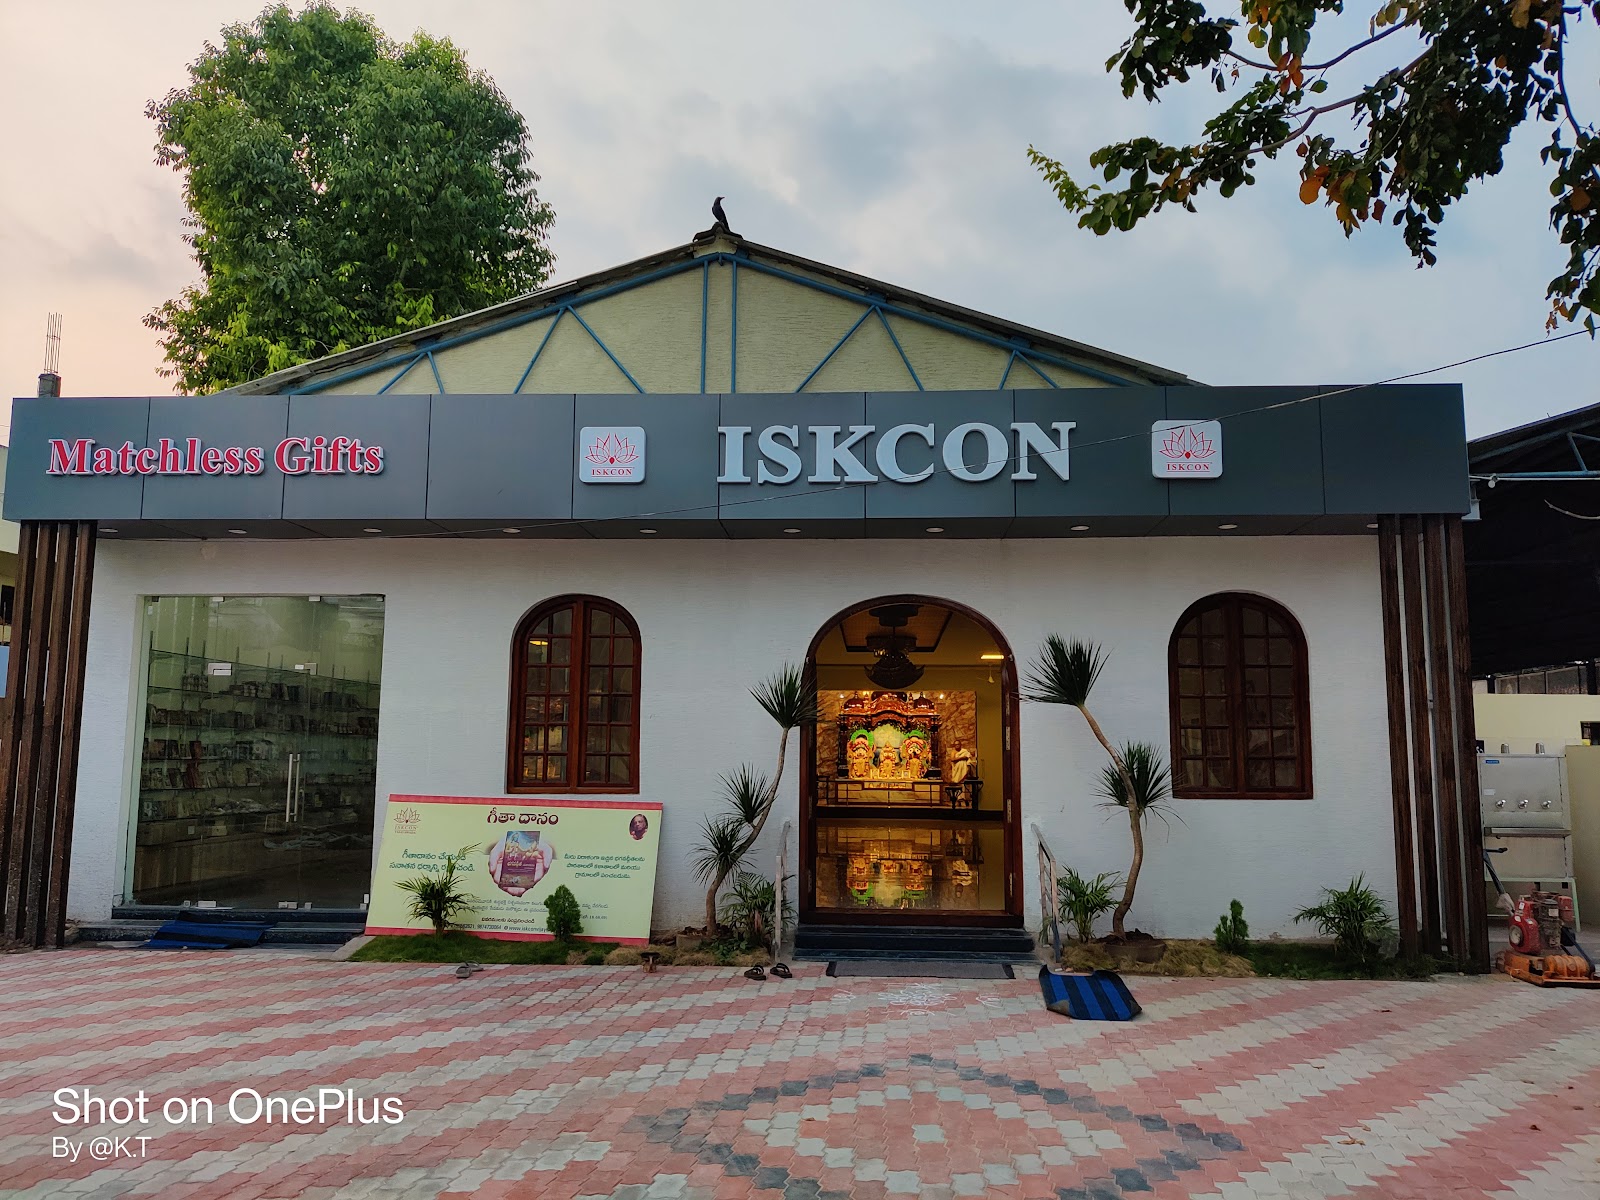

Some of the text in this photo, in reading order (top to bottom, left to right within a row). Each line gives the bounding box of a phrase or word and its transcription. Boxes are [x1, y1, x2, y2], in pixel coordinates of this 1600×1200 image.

[46, 434, 384, 476] Matchless Gifts
[717, 421, 1077, 485] ISKCON
[591, 468, 633, 476] ISKCON
[1167, 463, 1210, 471] ISKCON
[487, 807, 559, 825] గీతా దానం
